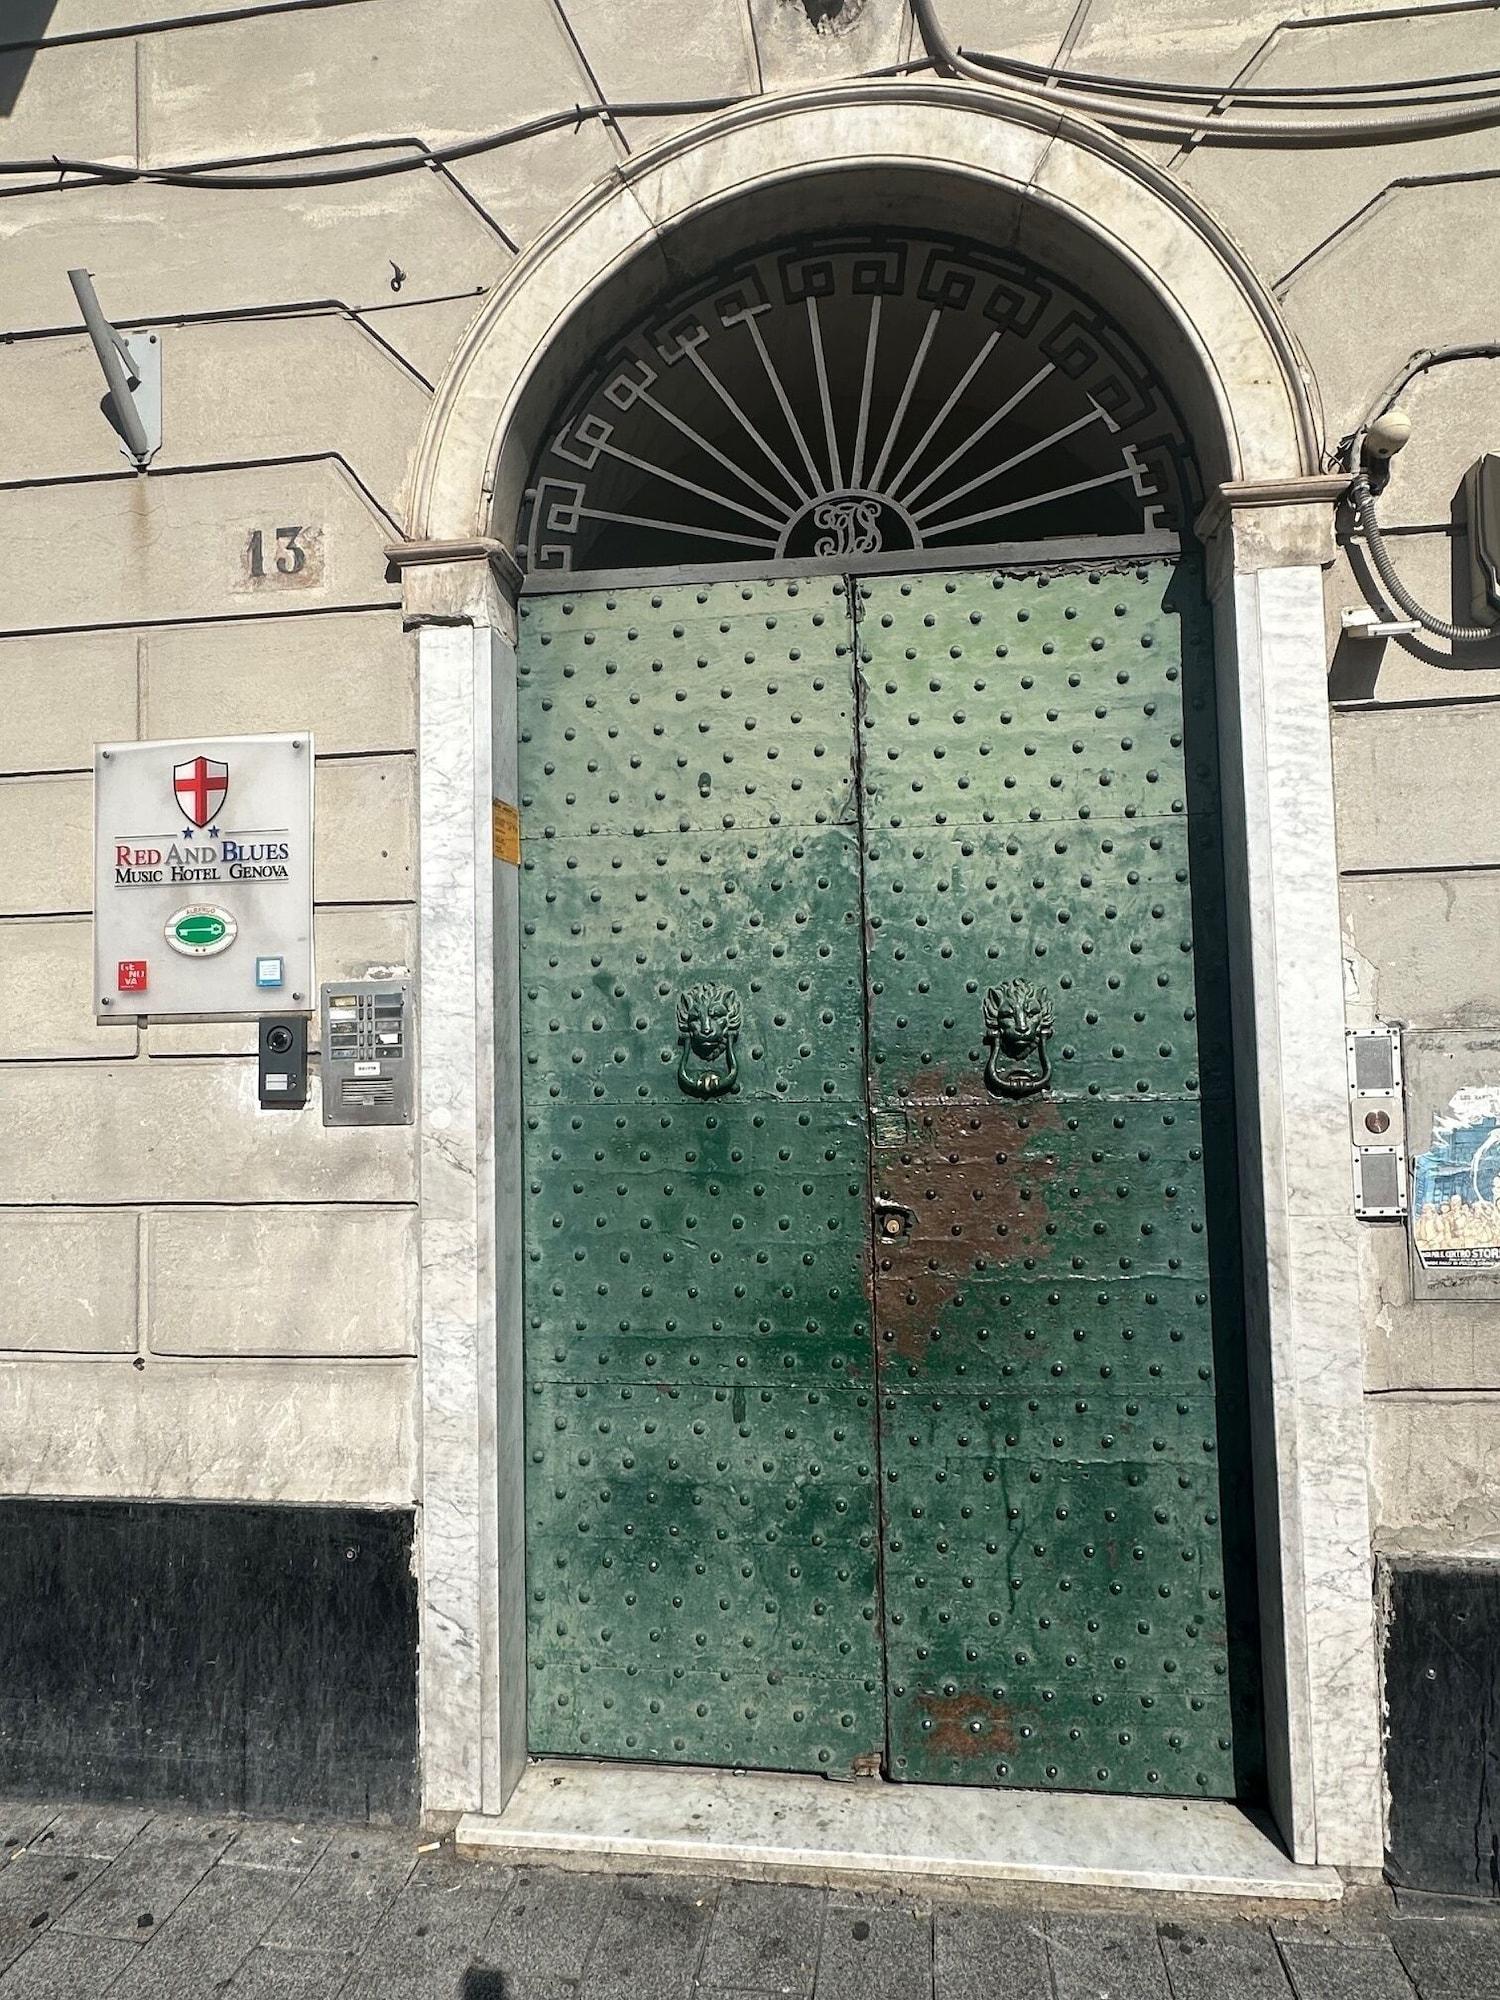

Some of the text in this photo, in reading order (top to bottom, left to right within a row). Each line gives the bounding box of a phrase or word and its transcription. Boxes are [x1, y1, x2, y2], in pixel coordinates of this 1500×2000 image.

[246, 526, 306, 578] 13
[115, 841, 289, 867] RED AND BLUES
[114, 862, 289, 884] MUSIC HOTEL GENOVA
